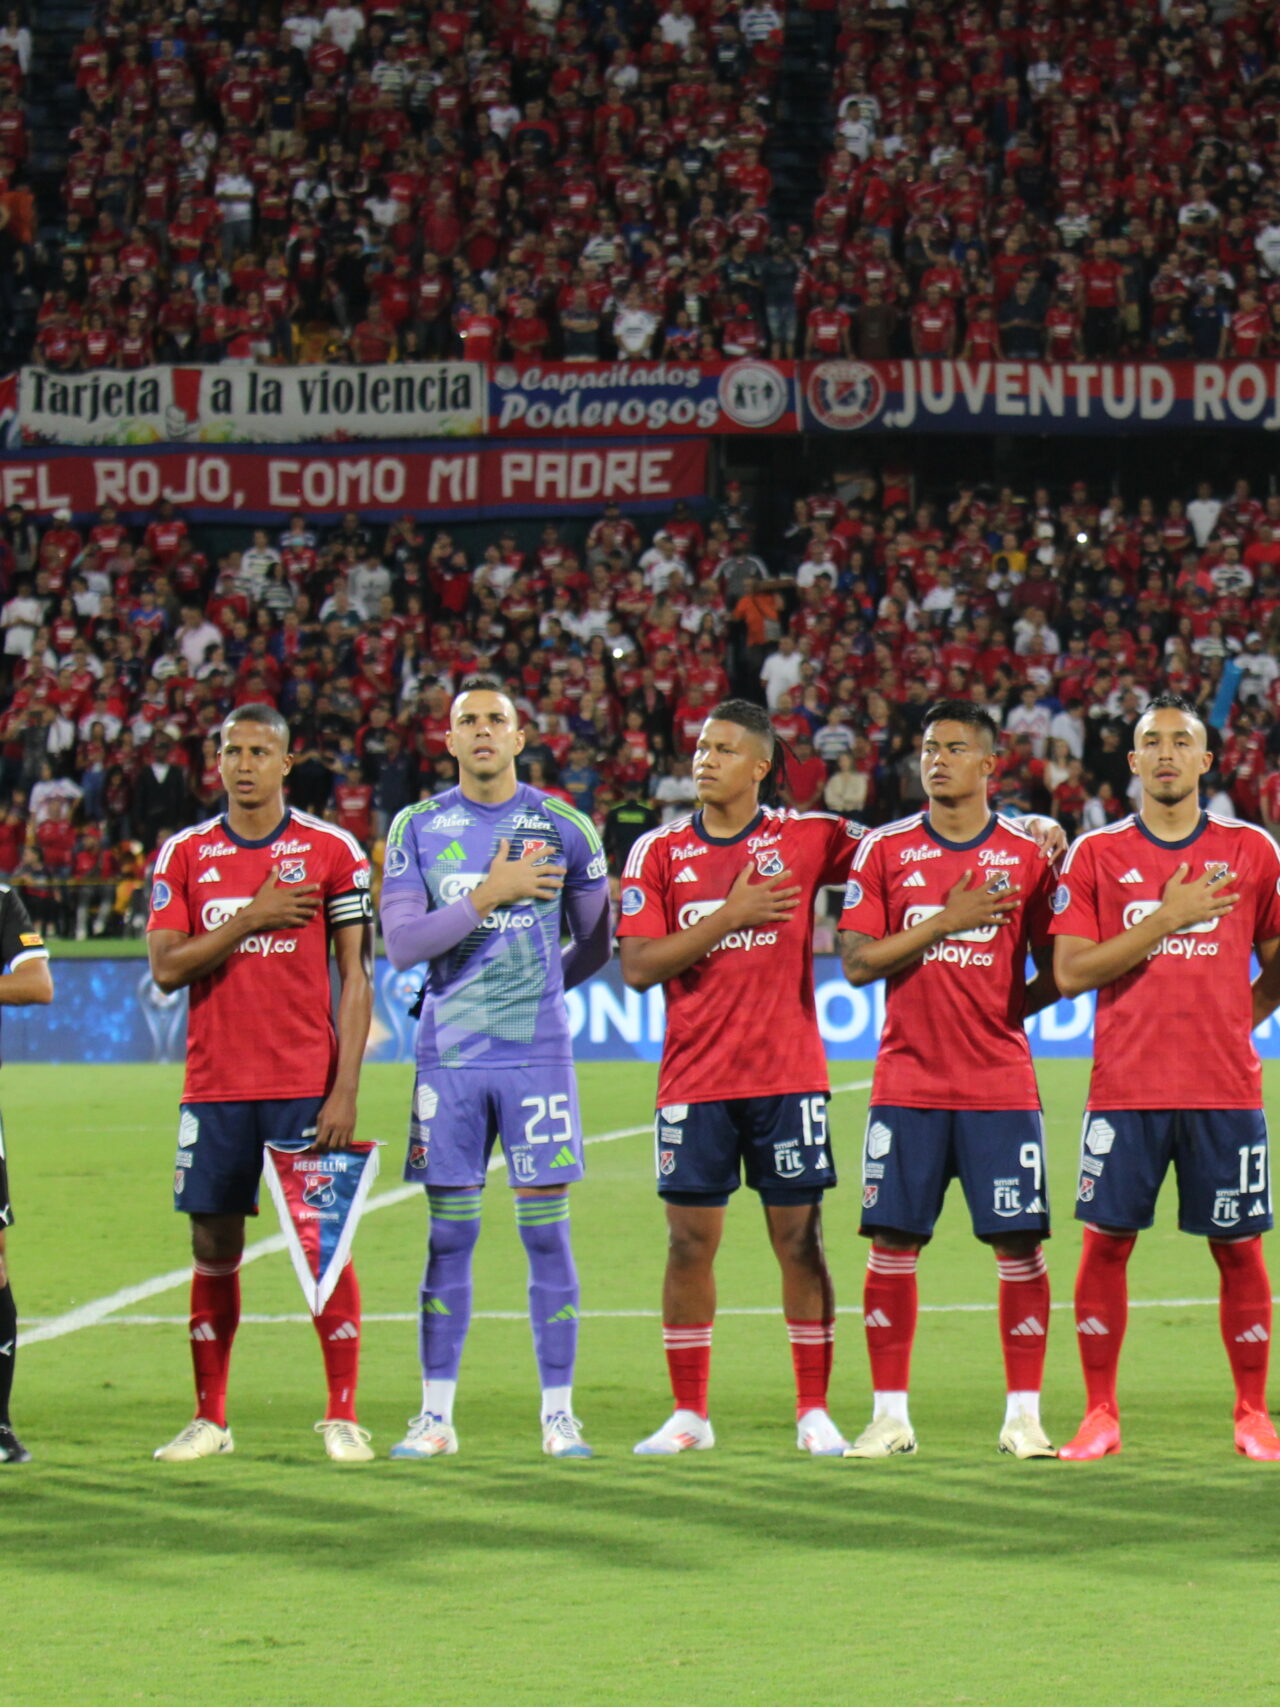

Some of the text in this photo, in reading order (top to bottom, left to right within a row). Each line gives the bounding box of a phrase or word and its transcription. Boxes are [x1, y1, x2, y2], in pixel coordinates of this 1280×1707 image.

[522, 363, 701, 394] Capacitados
[885, 360, 1176, 428] JUVENTUD
[30, 367, 473, 422] Tarjeta a la violencia
[498, 390, 721, 430] Poderosos
[2, 449, 674, 510] EL ROJO, COMO MI PADRE
[432, 814, 470, 830] Pilsen
[513, 814, 550, 831] Pilsen
[198, 842, 237, 861] Pilsen
[271, 839, 311, 858] Pilsen
[671, 843, 709, 861] Pilsen
[899, 844, 943, 866] Pilsen
[977, 850, 1021, 867] Pilsen
[923, 941, 993, 969] play.co
[520, 1093, 573, 1145] 25
[799, 1095, 828, 1146] 15
[1019, 1142, 1042, 1191] 9
[1238, 1144, 1267, 1194] 13
